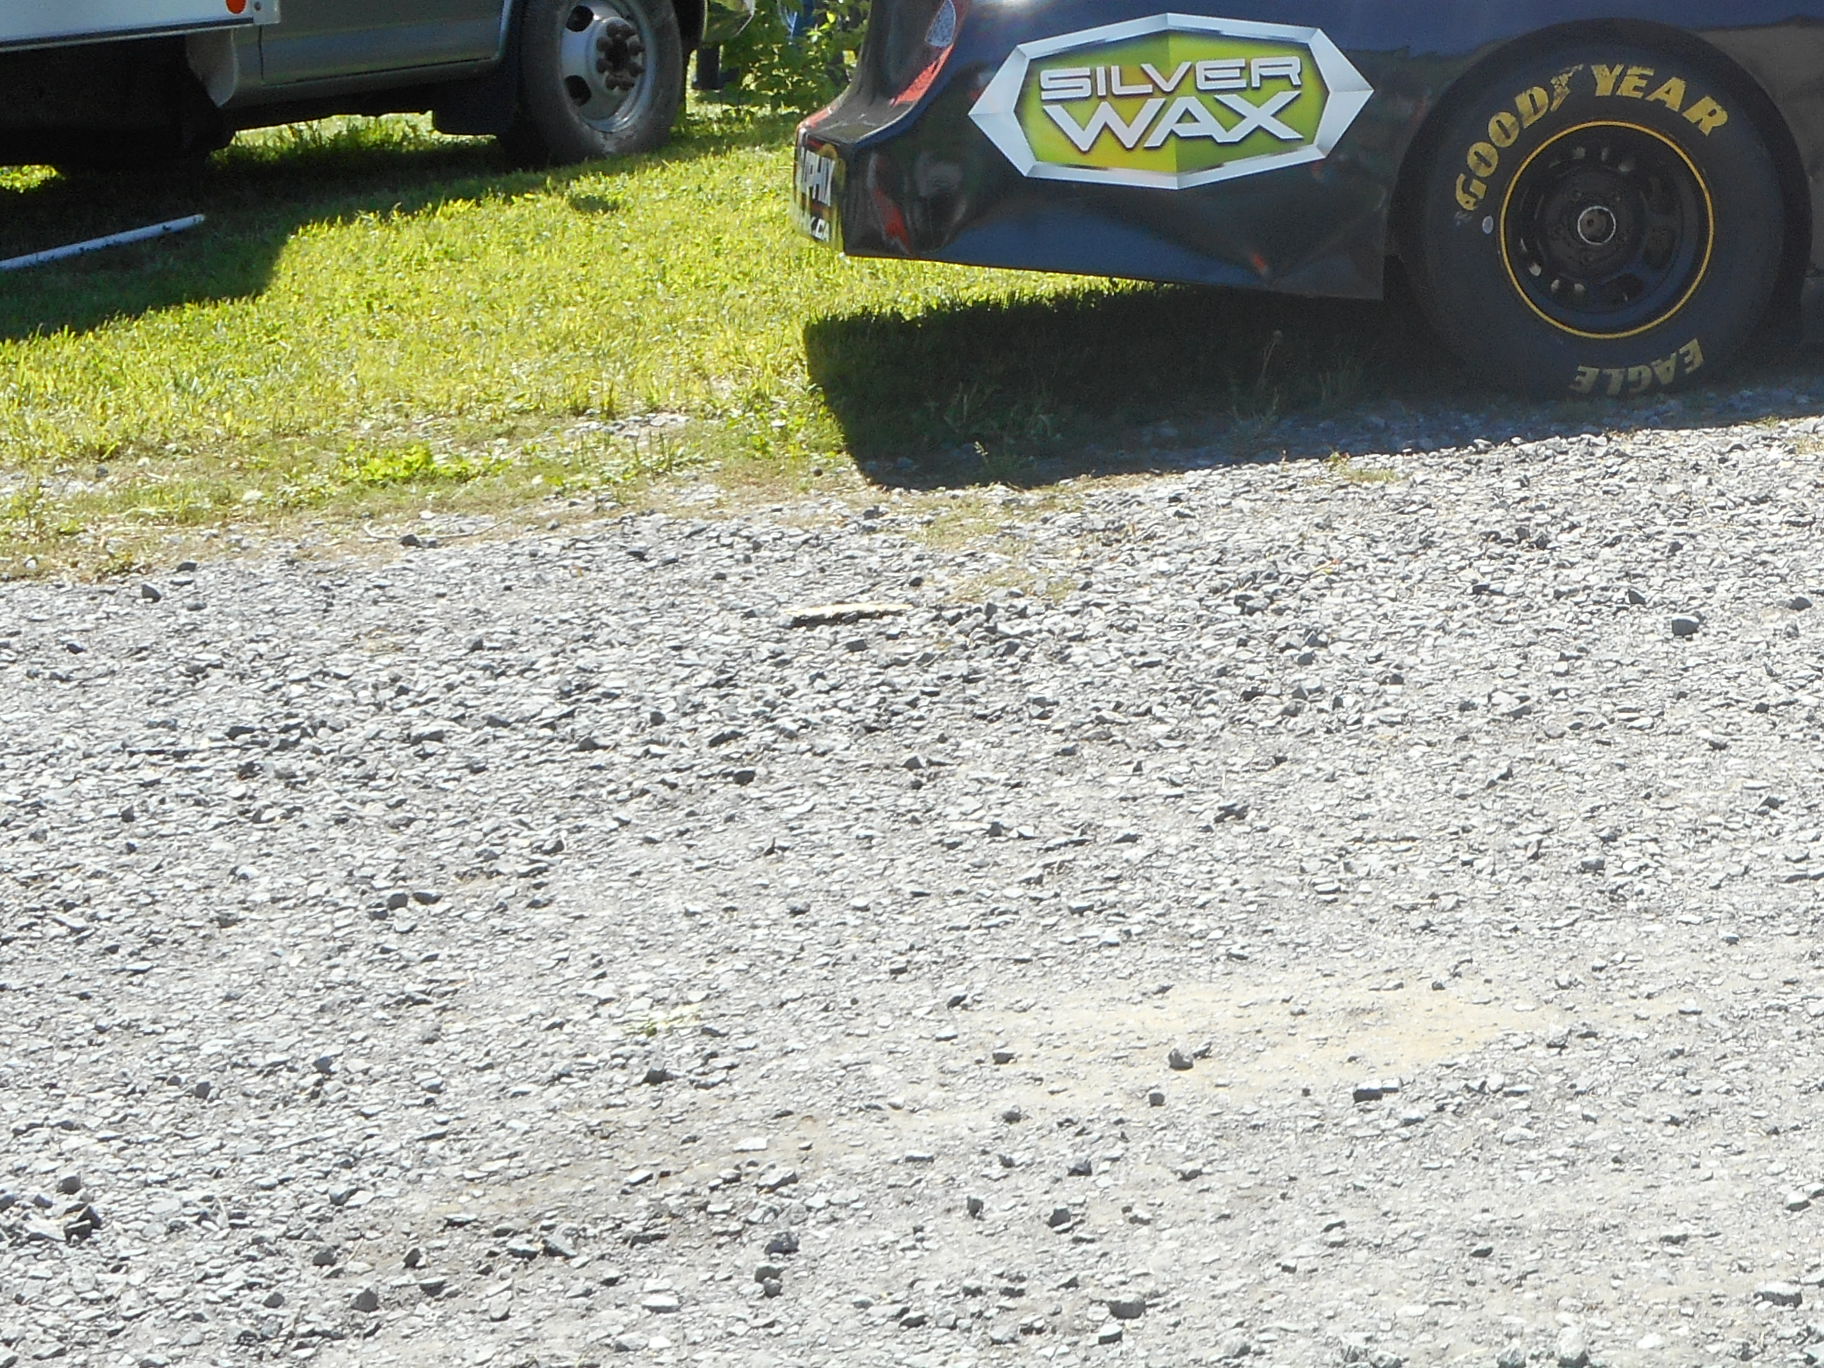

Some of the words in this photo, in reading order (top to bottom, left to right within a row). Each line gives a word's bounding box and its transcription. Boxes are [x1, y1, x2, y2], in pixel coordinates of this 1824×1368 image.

[1039, 56, 1303, 100] SILVER
[1042, 90, 1304, 153] WAX
[1569, 337, 1705, 396] EAGLE
